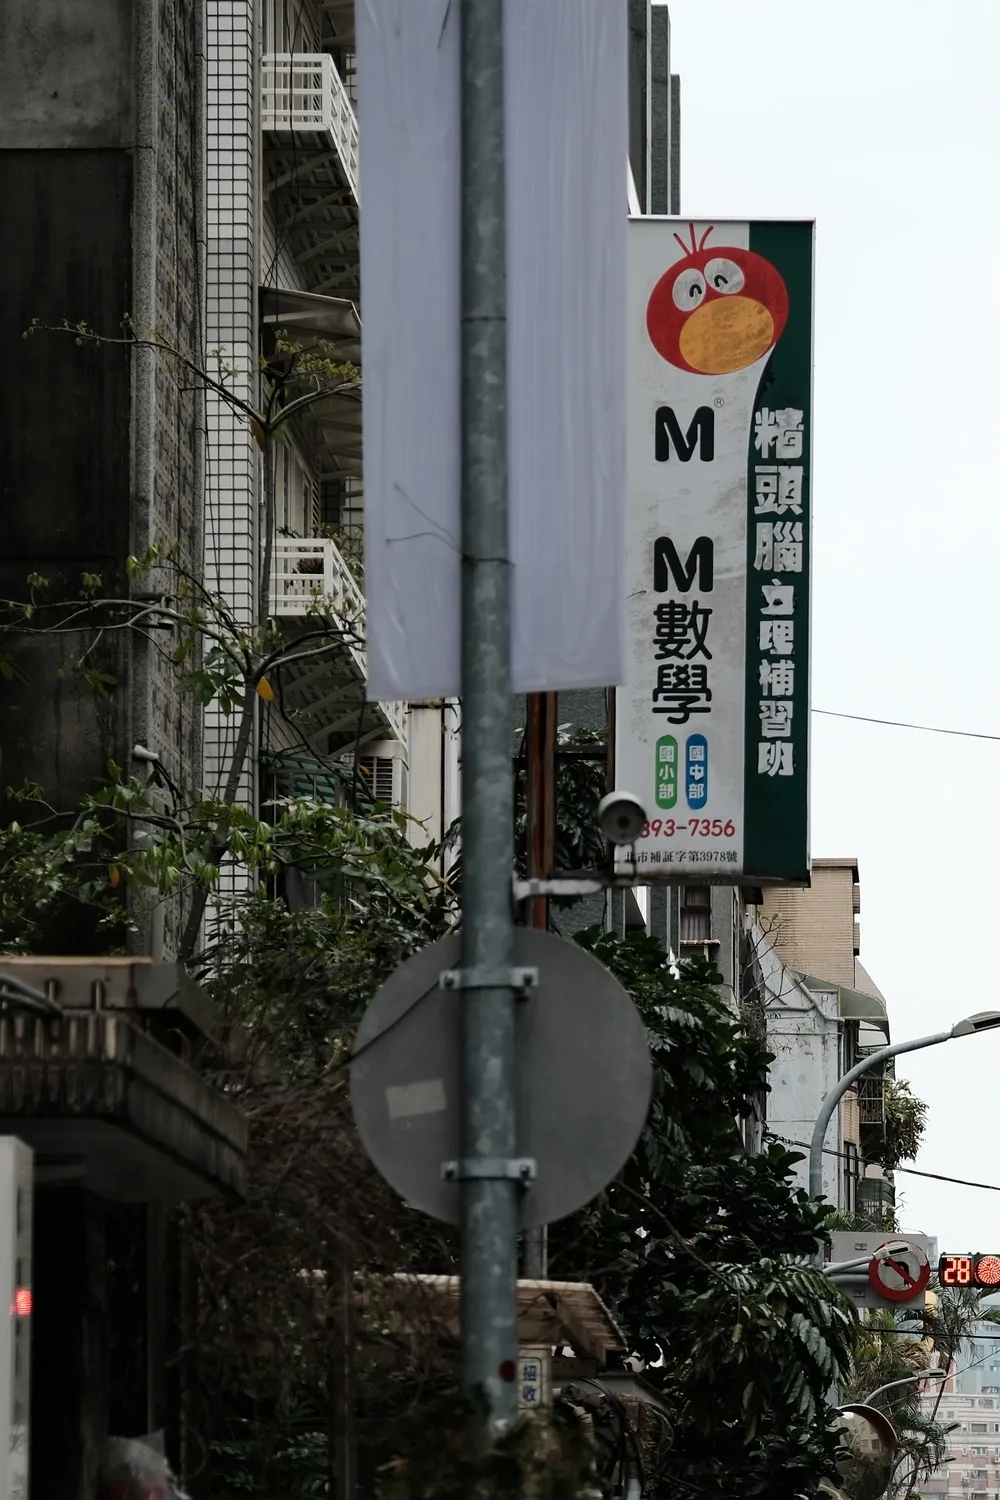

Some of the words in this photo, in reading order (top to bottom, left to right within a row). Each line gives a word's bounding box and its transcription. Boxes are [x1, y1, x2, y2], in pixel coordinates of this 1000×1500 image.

[654, 405, 715, 462] M
[659, 745, 675, 799] 國小部
[688, 745, 705, 799] 國中部
[943, 1257, 970, 1284] 28
